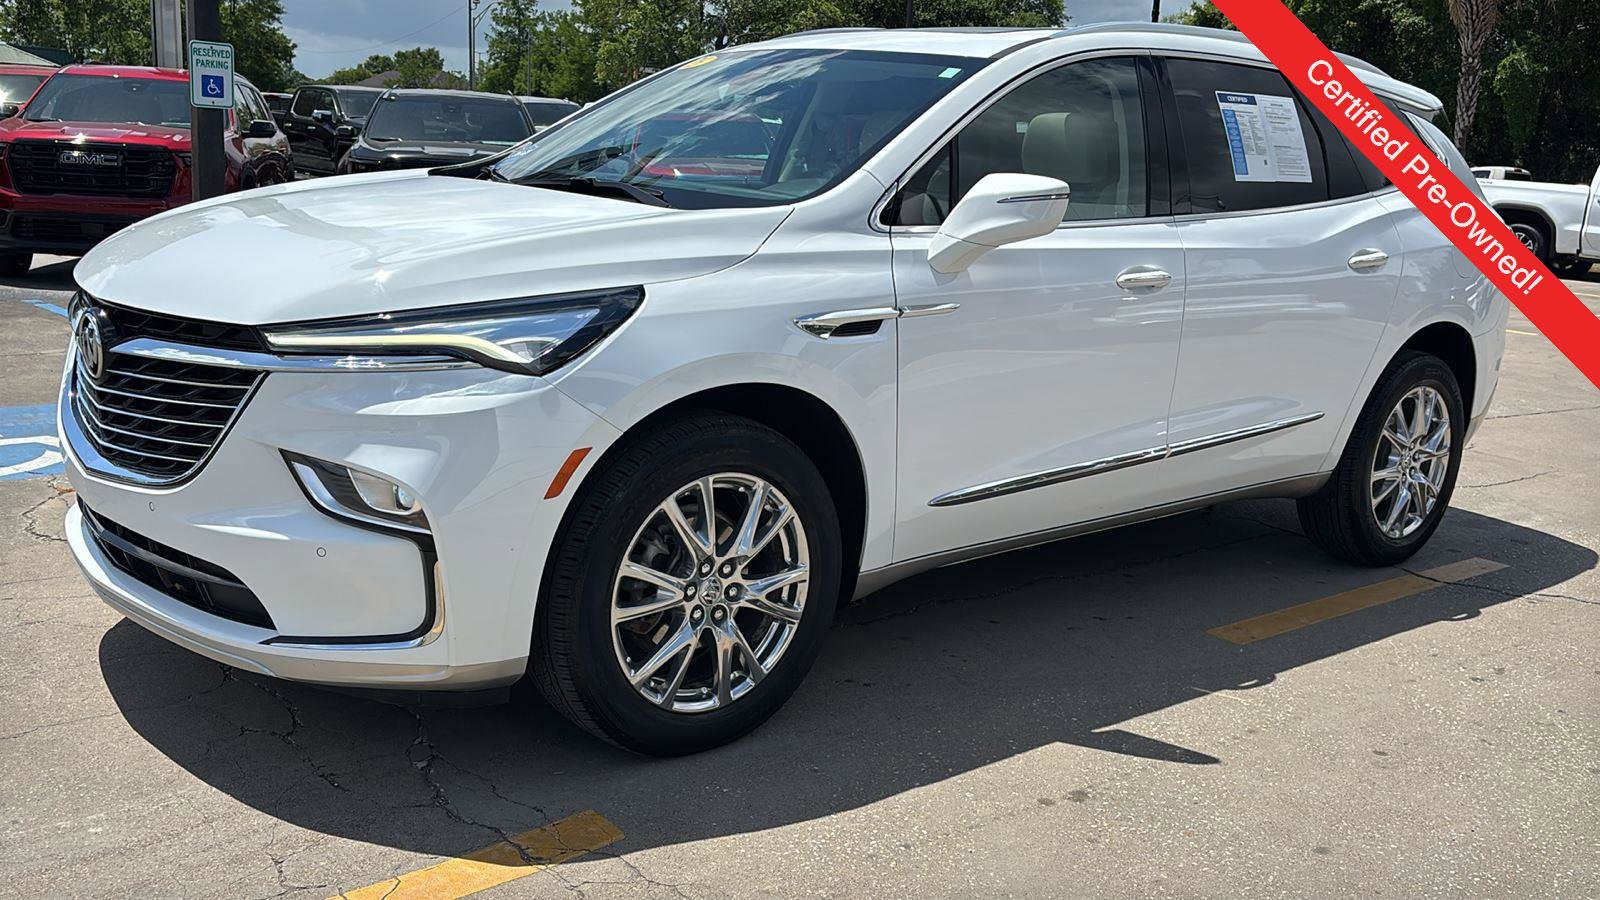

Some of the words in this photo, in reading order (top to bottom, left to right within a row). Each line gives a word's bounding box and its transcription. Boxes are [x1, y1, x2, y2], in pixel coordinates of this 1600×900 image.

[192, 47, 231, 59] RESERVED
[195, 58, 229, 70] PARKING
[60, 150, 120, 166] GMC
